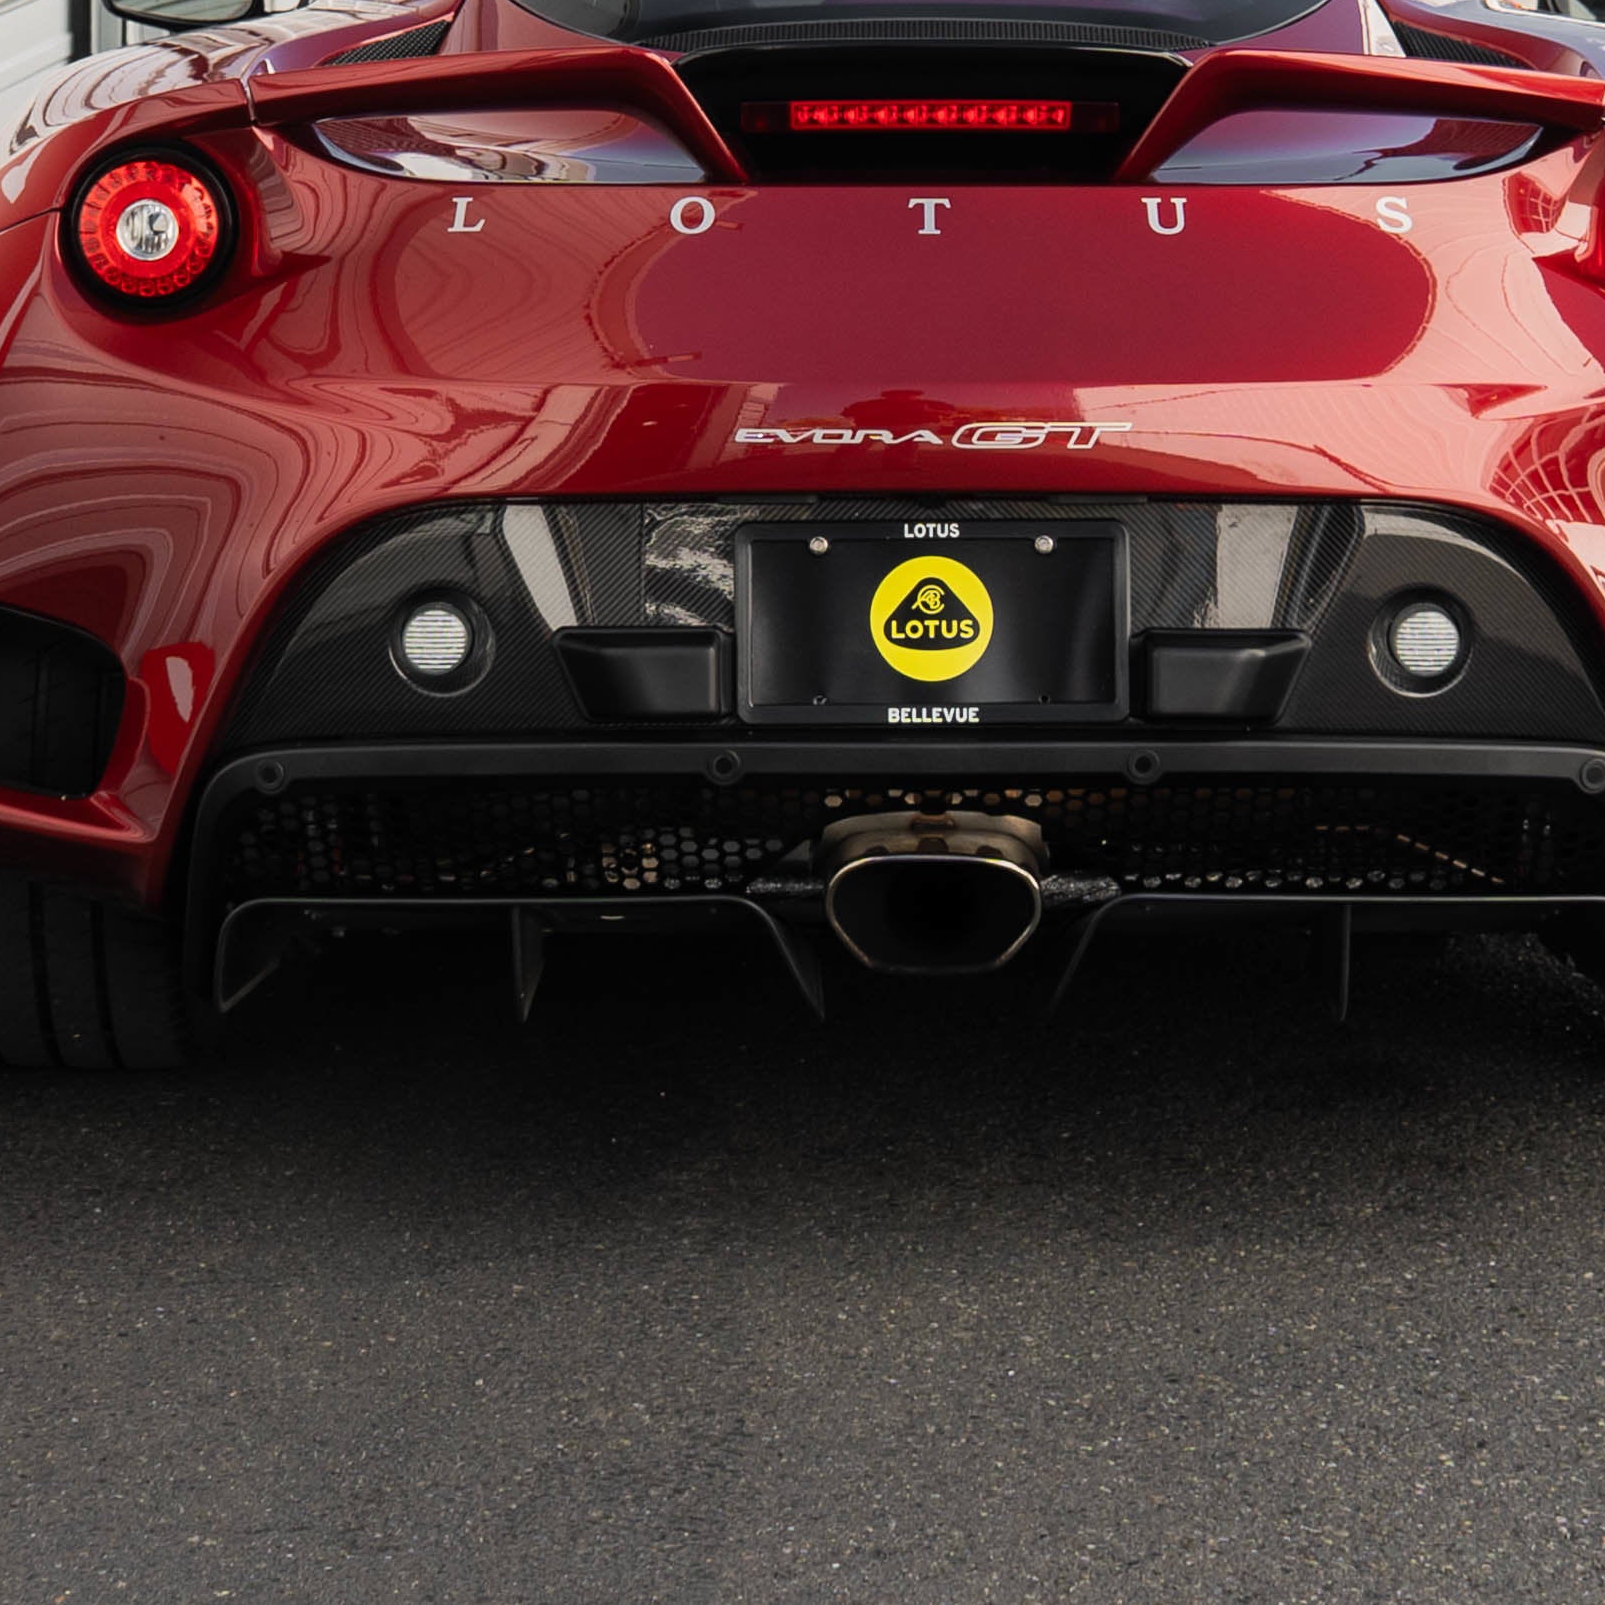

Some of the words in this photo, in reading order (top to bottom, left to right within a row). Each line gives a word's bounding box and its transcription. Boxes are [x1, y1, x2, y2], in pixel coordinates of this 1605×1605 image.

[735, 428, 943, 444] EVORA
[951, 422, 1132, 450] GT
[904, 523, 960, 538] LOTUS
[891, 620, 974, 639] LOTUS
[887, 707, 980, 723] BELLEVUE
